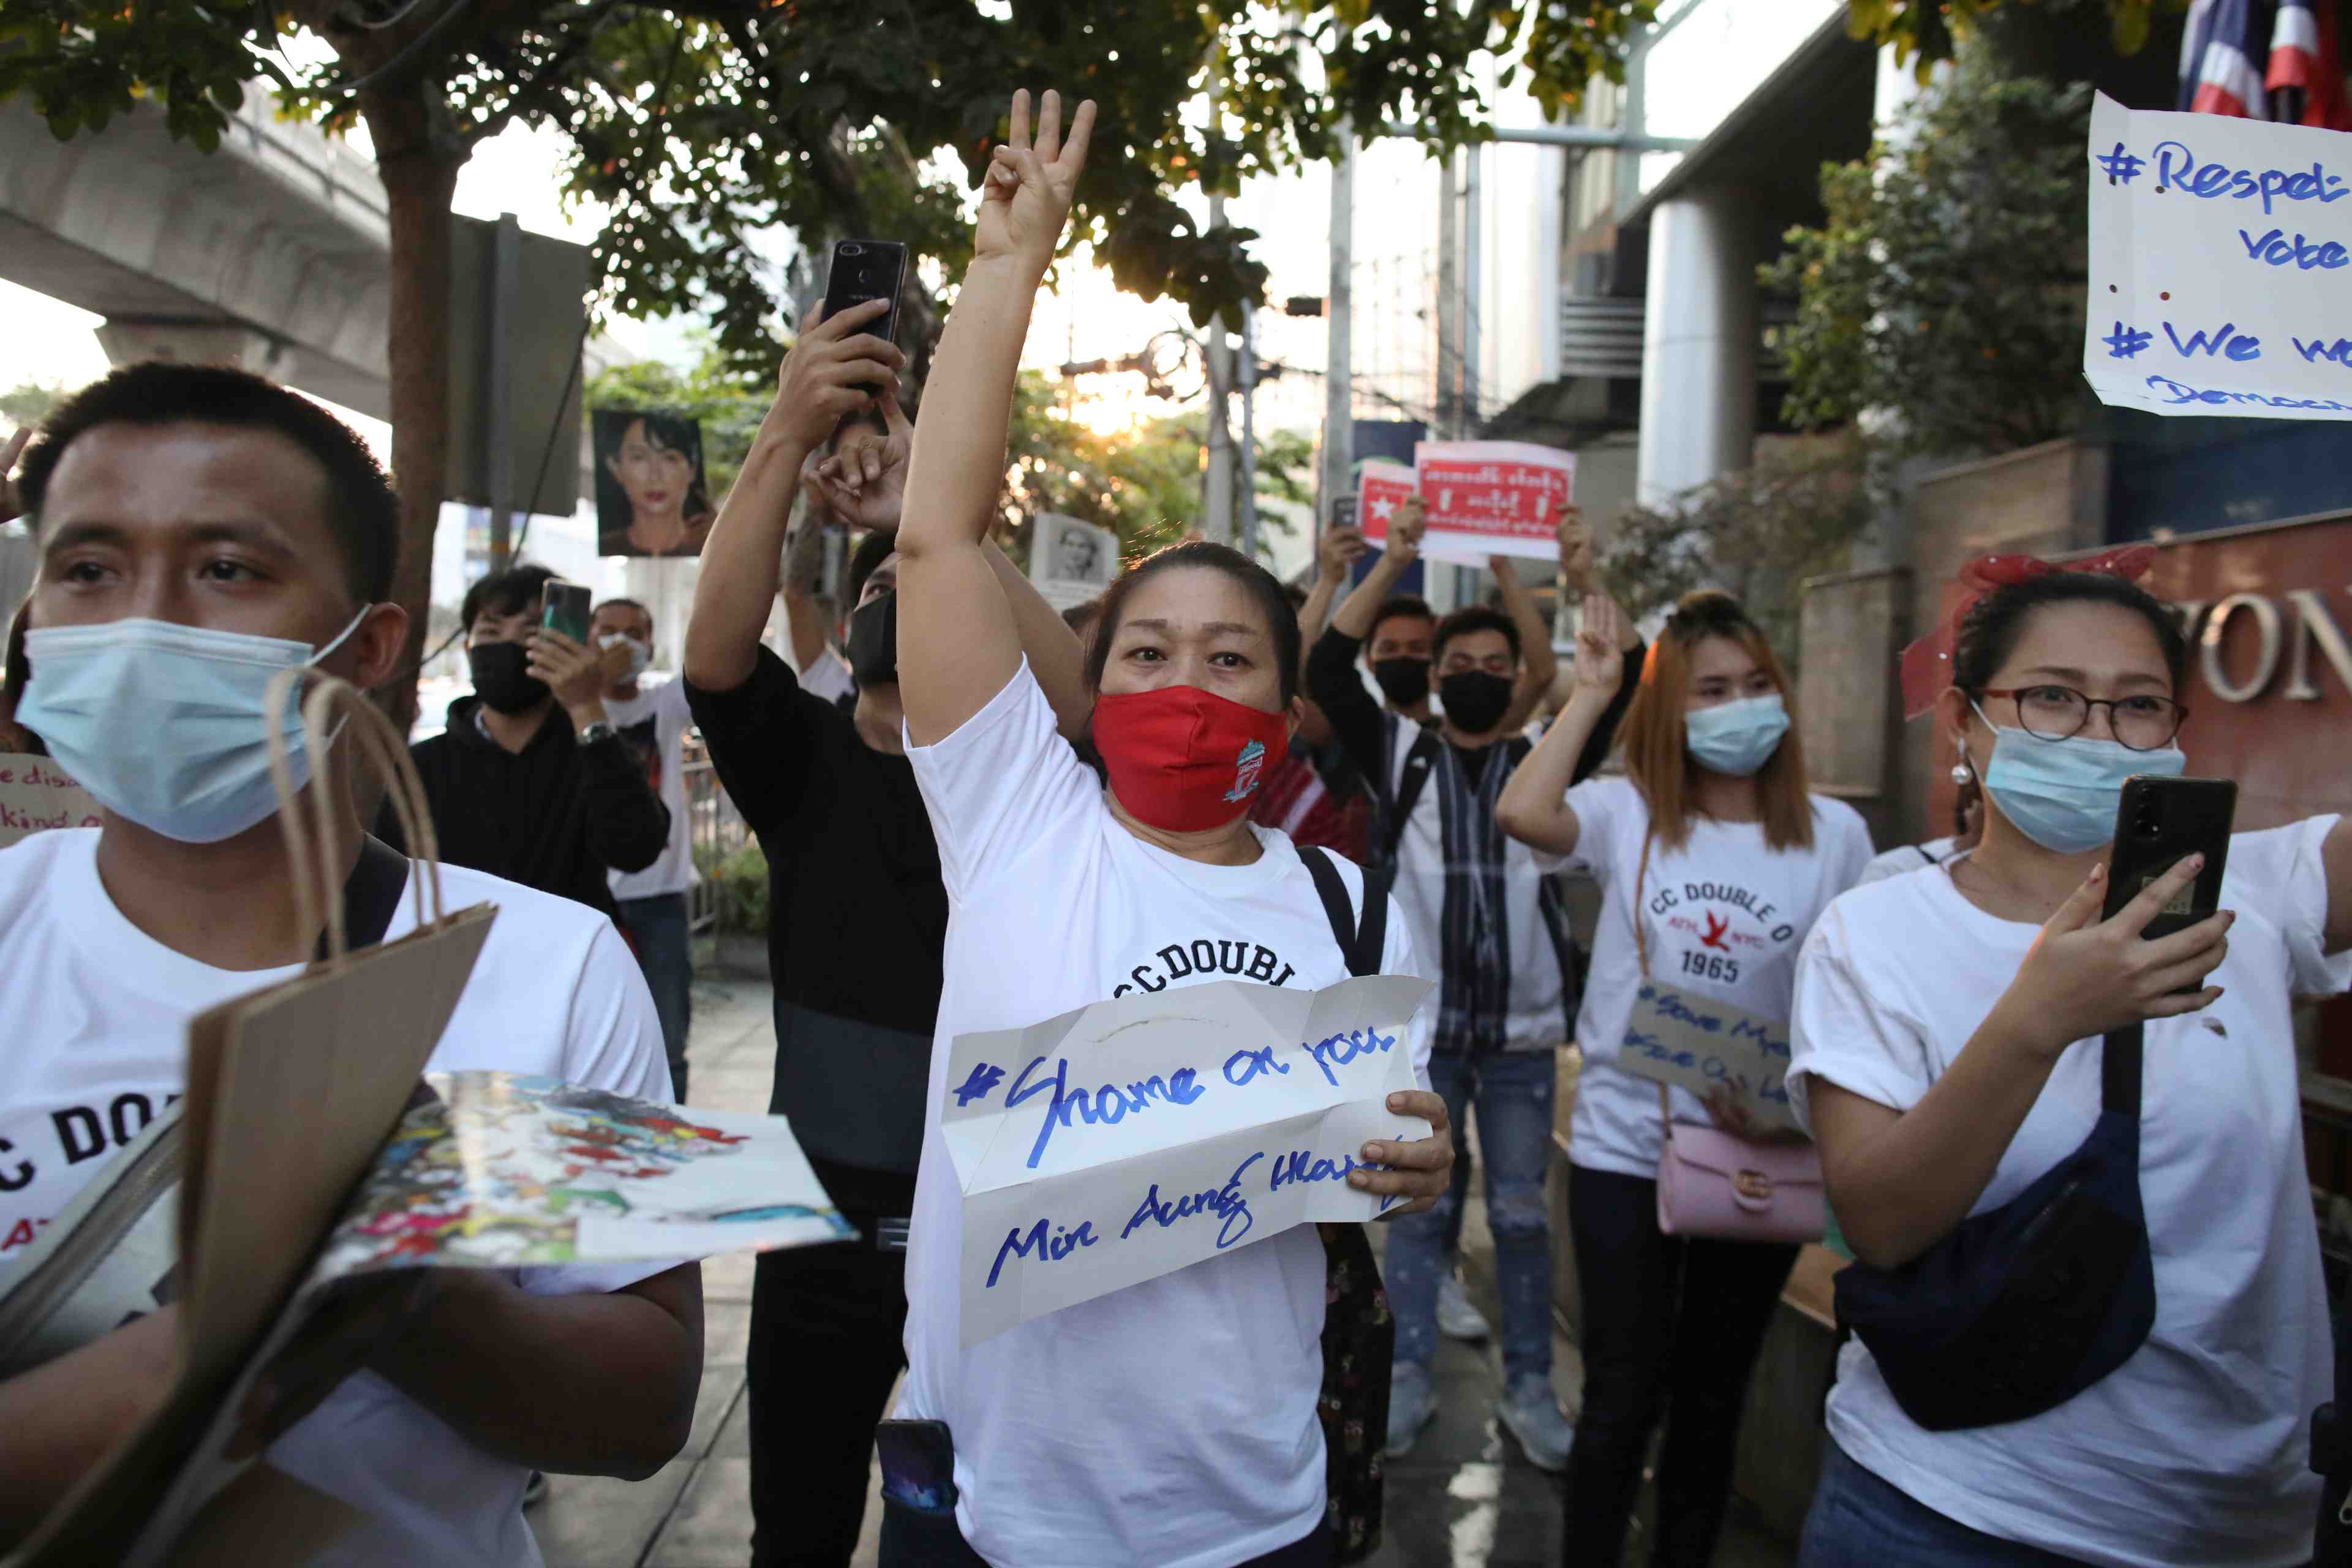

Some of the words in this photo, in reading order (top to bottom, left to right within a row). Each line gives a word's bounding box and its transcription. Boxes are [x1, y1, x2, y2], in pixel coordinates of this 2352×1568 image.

[1651, 888, 1679, 915] CC
[1684, 882, 1777, 922] DOUBLE
[1771, 924, 1793, 942] O
[1682, 950, 1739, 984] 1965
[1223, 1045, 1290, 1087] on
[1302, 1026, 1396, 1087] you
[986, 1218, 1099, 1289] Min
[1120, 1152, 1265, 1250] Aung
